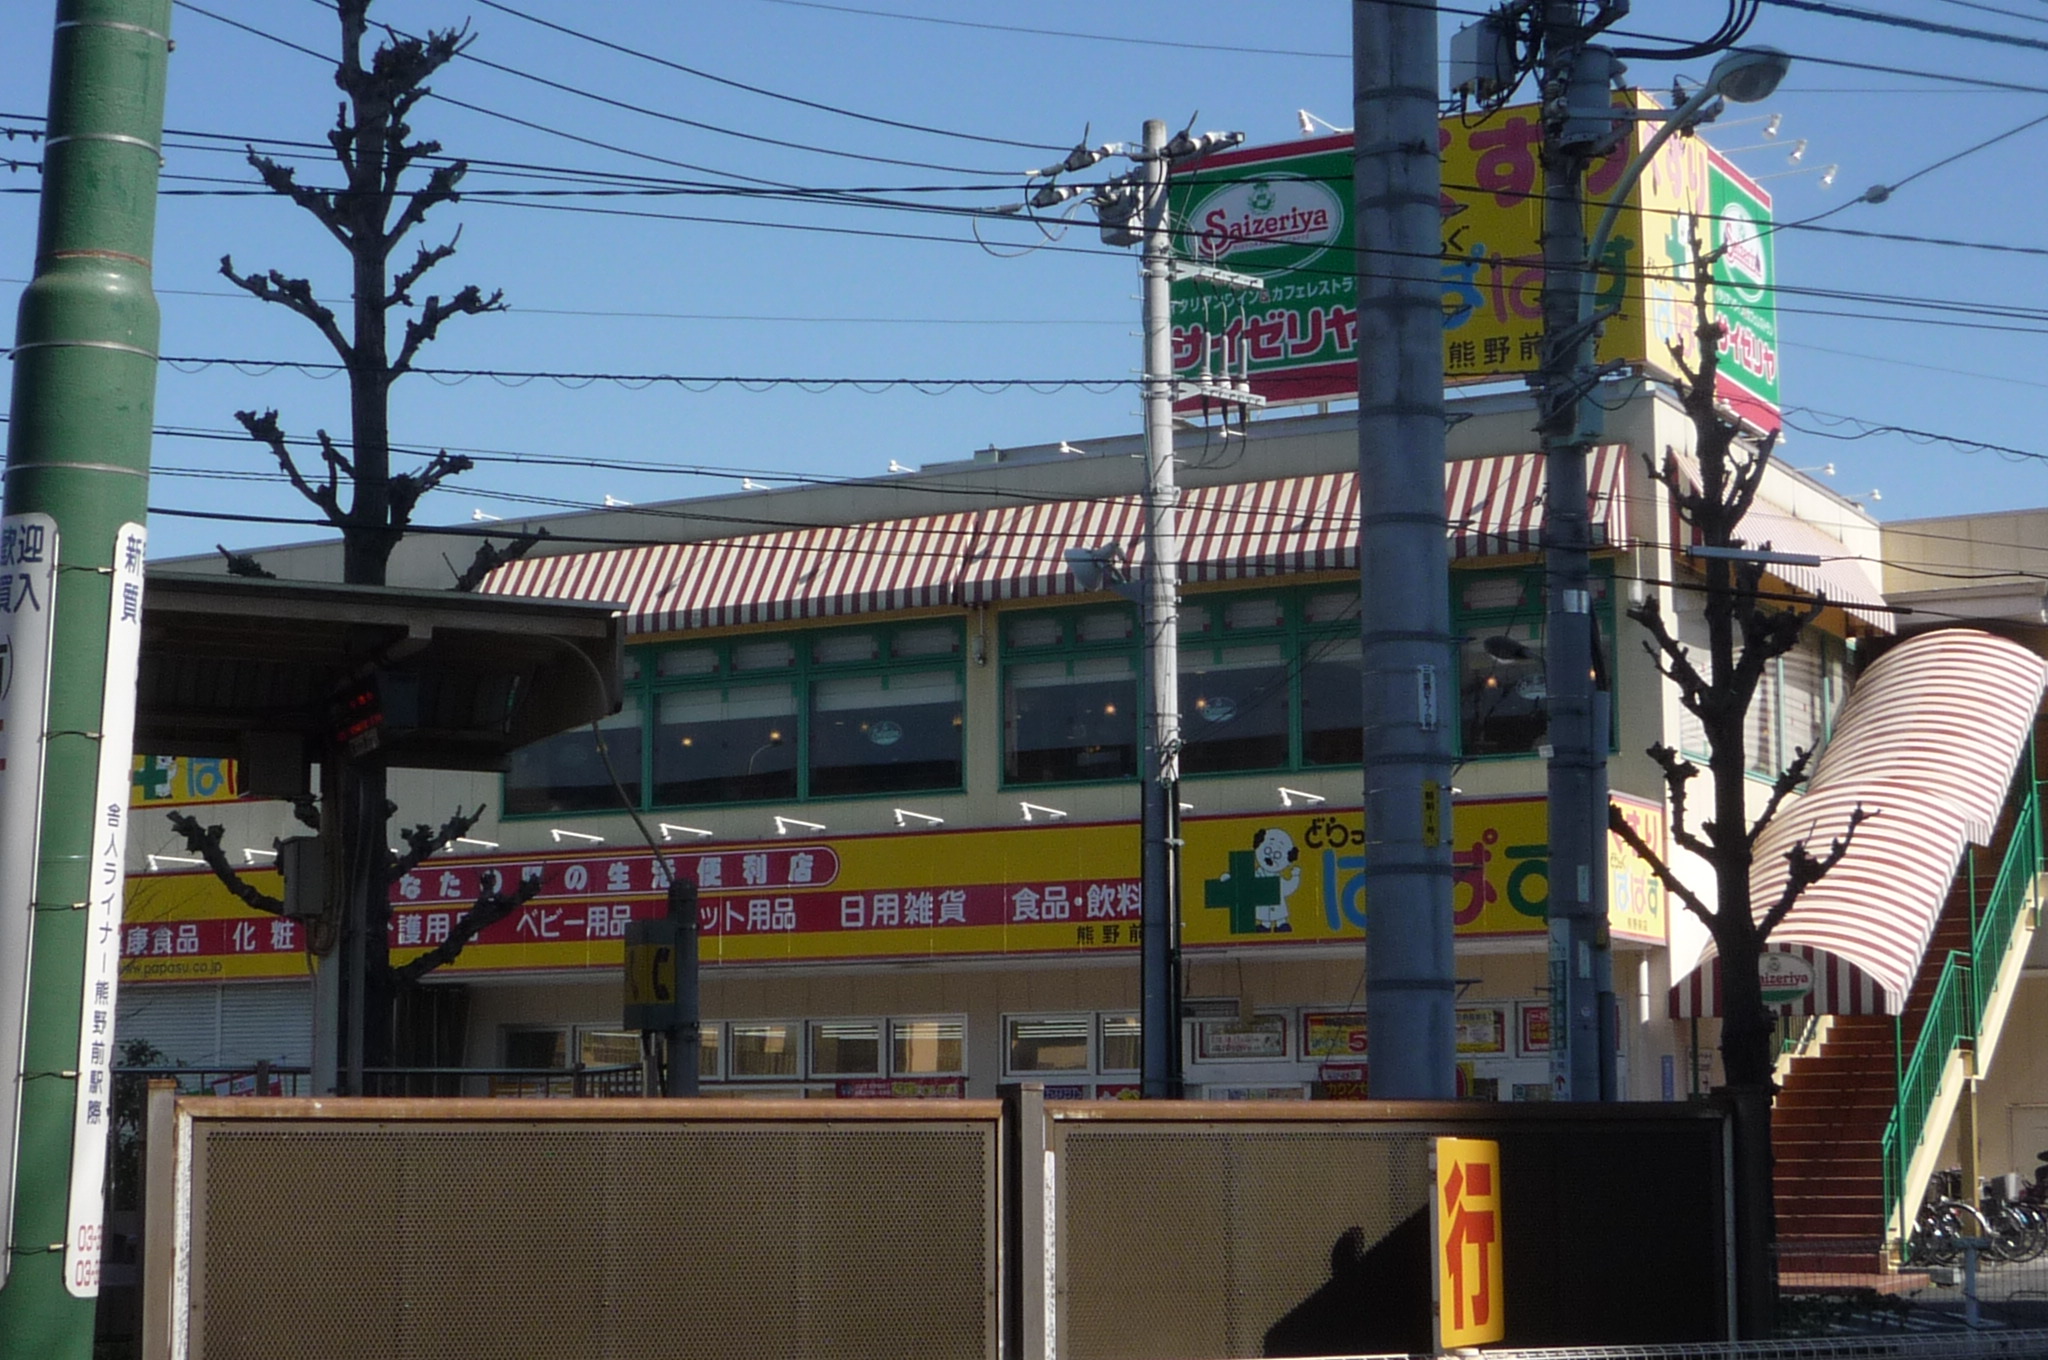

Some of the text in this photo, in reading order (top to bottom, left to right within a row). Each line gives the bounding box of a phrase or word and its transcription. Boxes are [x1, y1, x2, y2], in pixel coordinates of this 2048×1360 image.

[1200, 207, 1329, 259] Saizeriya
[516, 905, 632, 939] ベビー用品
[840, 889, 967, 928] 日用雑貨
[1444, 1160, 1496, 1330] 行
